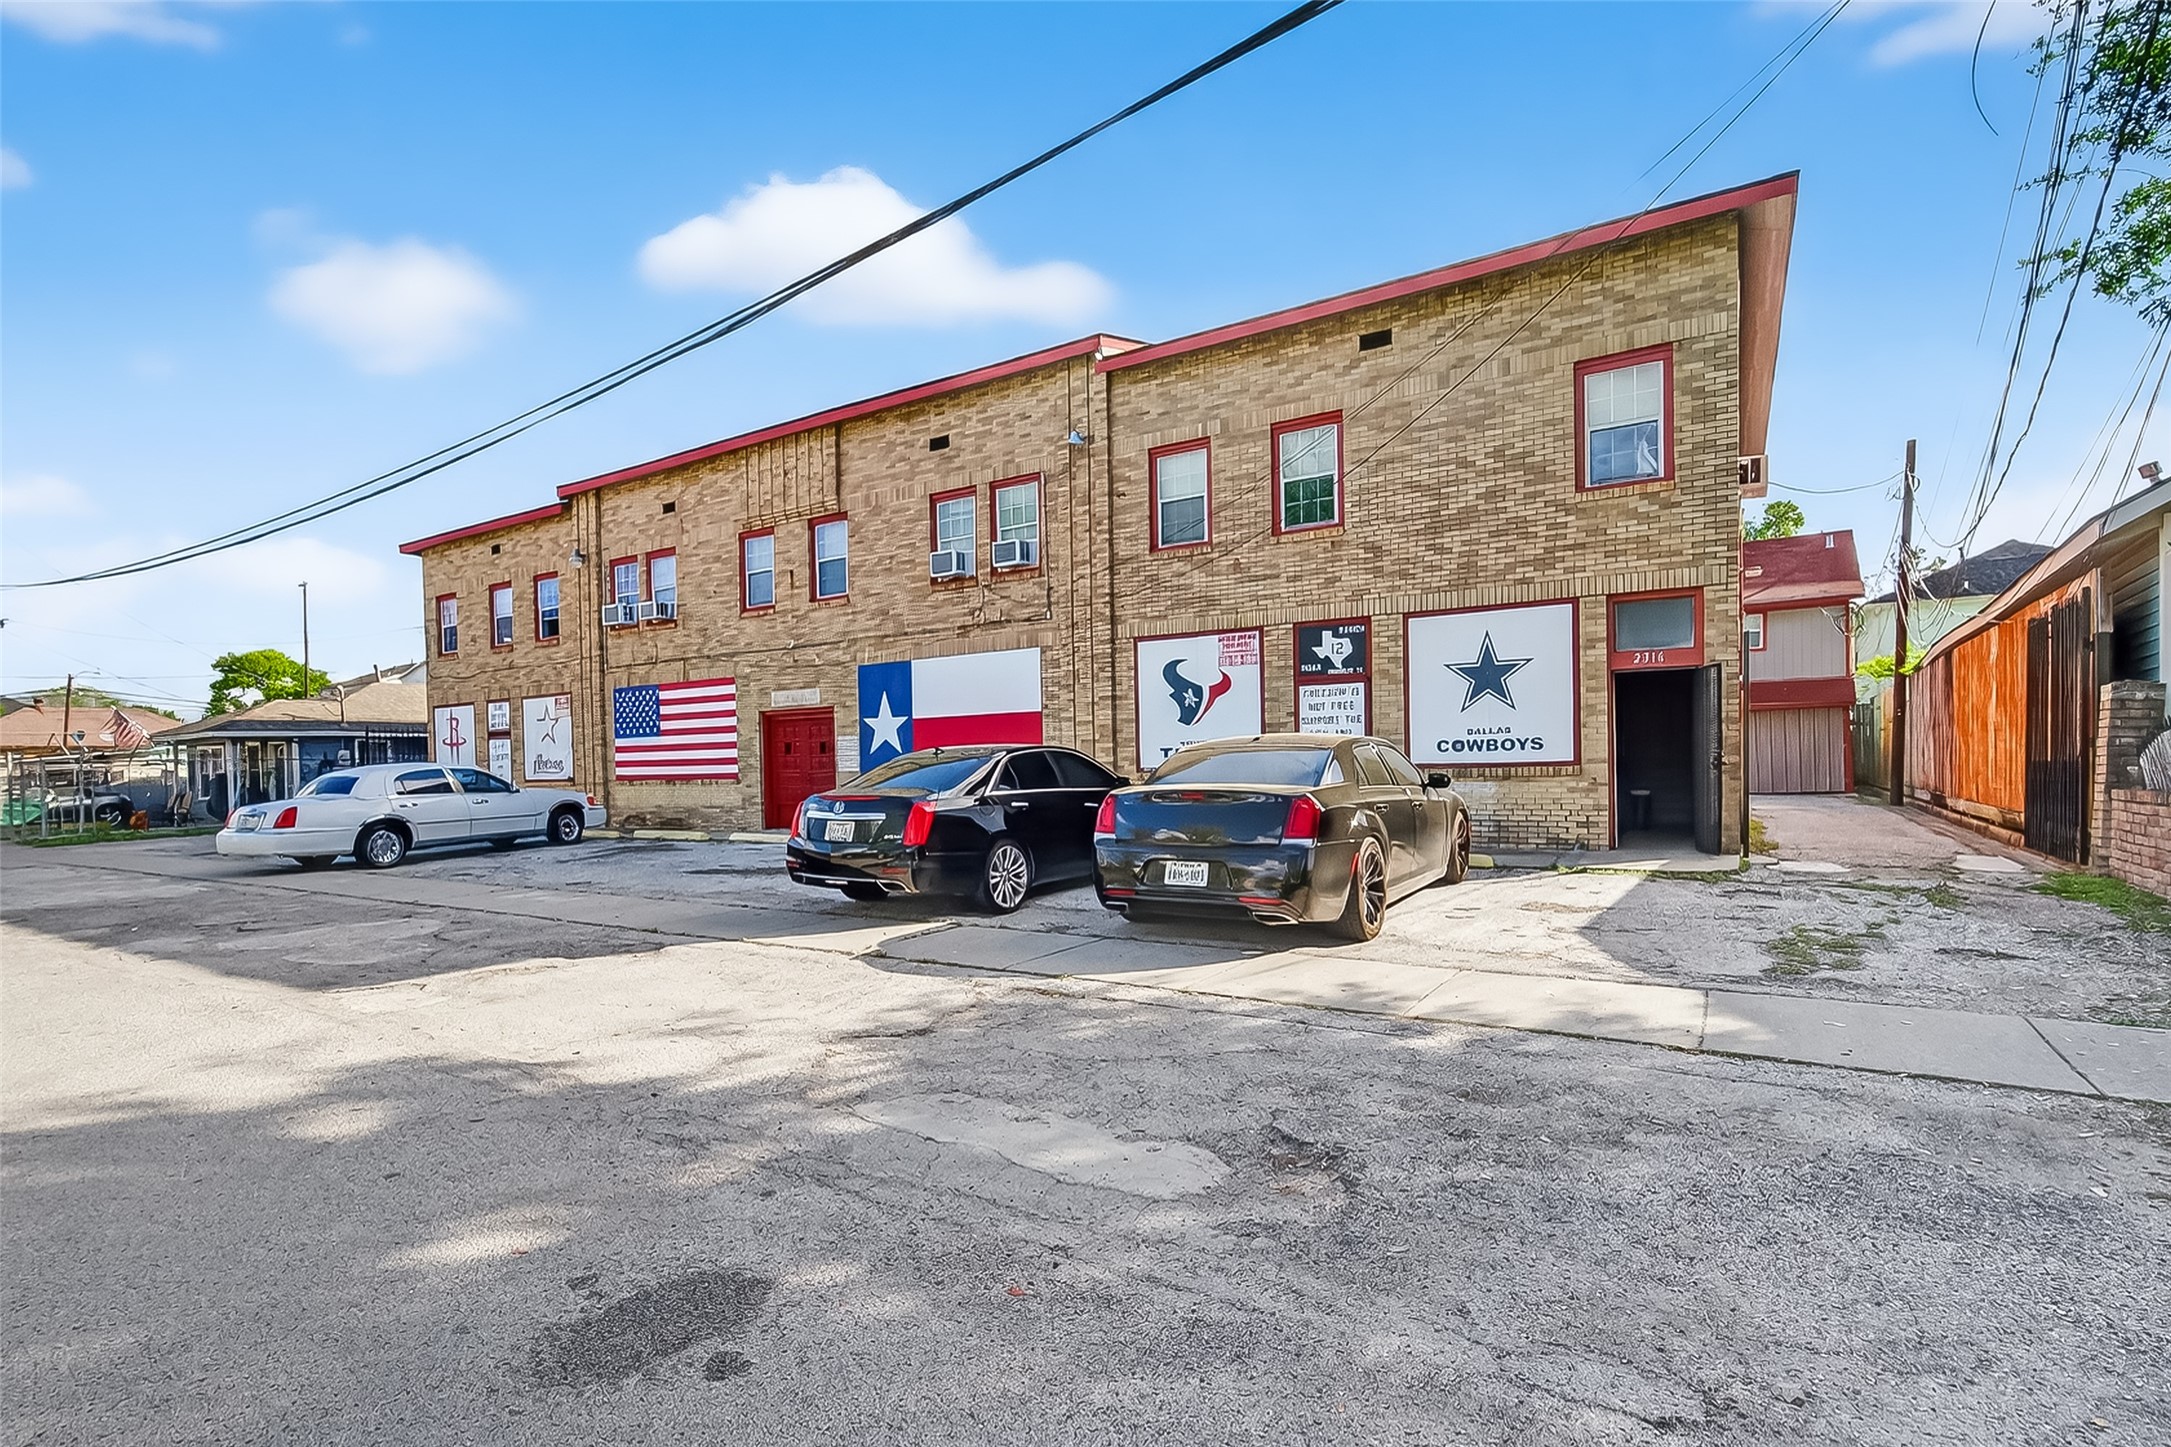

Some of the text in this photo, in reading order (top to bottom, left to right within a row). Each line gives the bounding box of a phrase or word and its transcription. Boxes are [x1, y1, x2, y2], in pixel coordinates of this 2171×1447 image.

[1331, 642, 1344, 655] 12
[1467, 726, 1512, 736] DALLAS
[1436, 736, 1545, 753] COWBOYS
